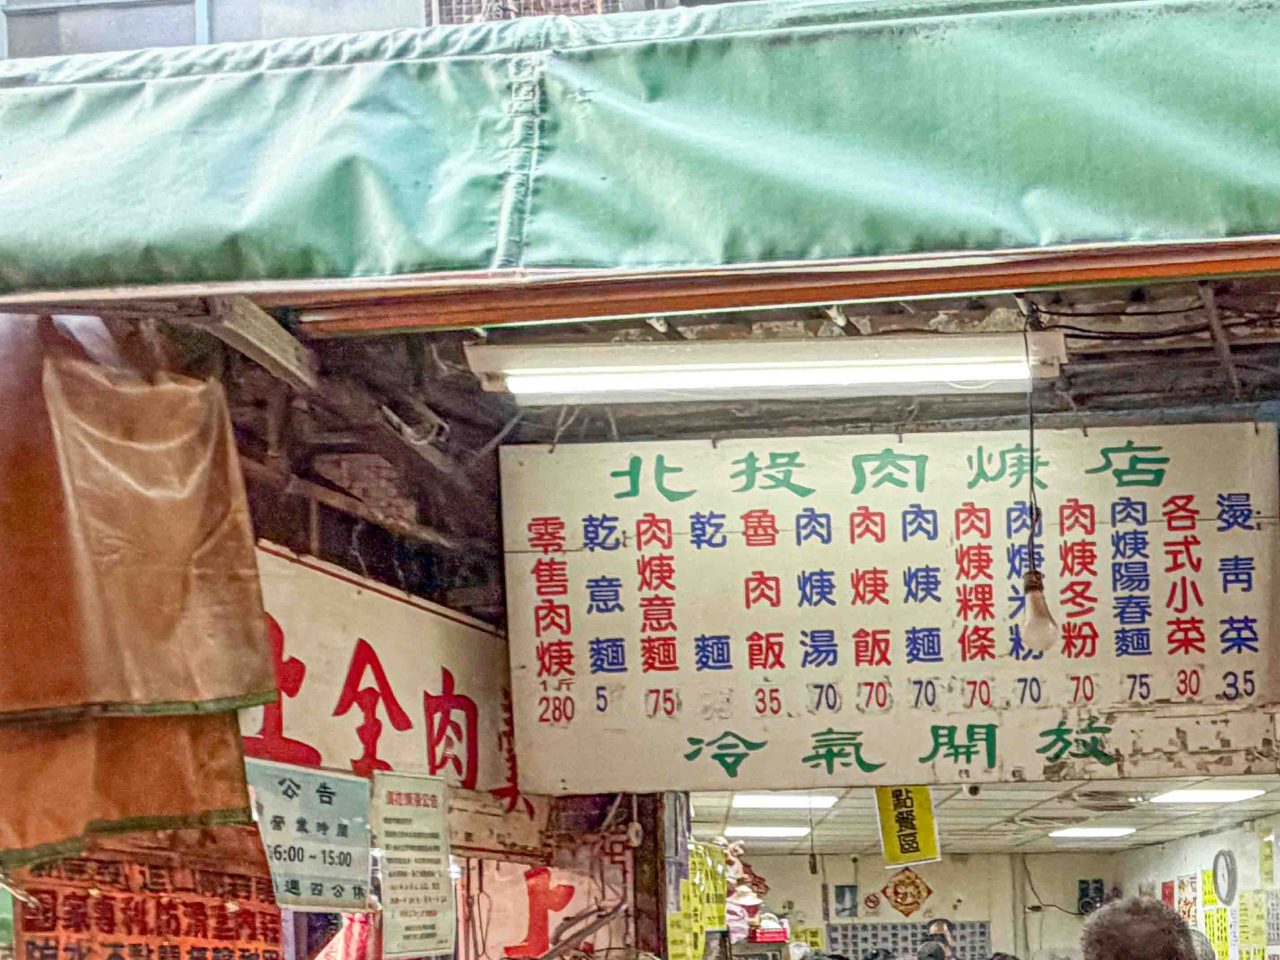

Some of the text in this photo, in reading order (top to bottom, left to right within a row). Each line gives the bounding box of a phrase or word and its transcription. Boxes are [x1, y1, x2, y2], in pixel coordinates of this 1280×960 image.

[610, 440, 1170, 502] 北投肉焿店
[527, 516, 575, 678] 零售肉焿
[582, 513, 628, 675] 乾意麵
[636, 512, 680, 674] 肉焿意麵
[690, 511, 733, 672] 乾麵
[740, 508, 786, 671] 魯肉飯
[795, 507, 839, 668] 肉焿湯
[849, 506, 891, 668] 肉焿飯
[902, 503, 943, 665] 肉焿麵
[954, 501, 996, 662] 肉焿粿條
[1058, 498, 1099, 659] 肉焿冬粉
[1111, 496, 1152, 657] 肉焿陽春麵
[1162, 494, 1207, 656] 各式小菜
[1216, 493, 1259, 655] 燙青菜
[537, 697, 575, 723] 280
[648, 688, 676, 717] 75
[755, 688, 782, 716] 35
[813, 684, 838, 711] 70
[863, 682, 888, 709] 70
[912, 680, 936, 708] 70
[966, 680, 991, 707] 70
[1017, 678, 1042, 704] 70
[1071, 675, 1095, 702] 70
[1127, 673, 1151, 700] 75
[1176, 669, 1200, 697] 30
[1223, 671, 1256, 701] 35
[683, 721, 1116, 778] 冷氣開放
[278, 777, 337, 806] 公告
[321, 850, 352, 868] 15:00
